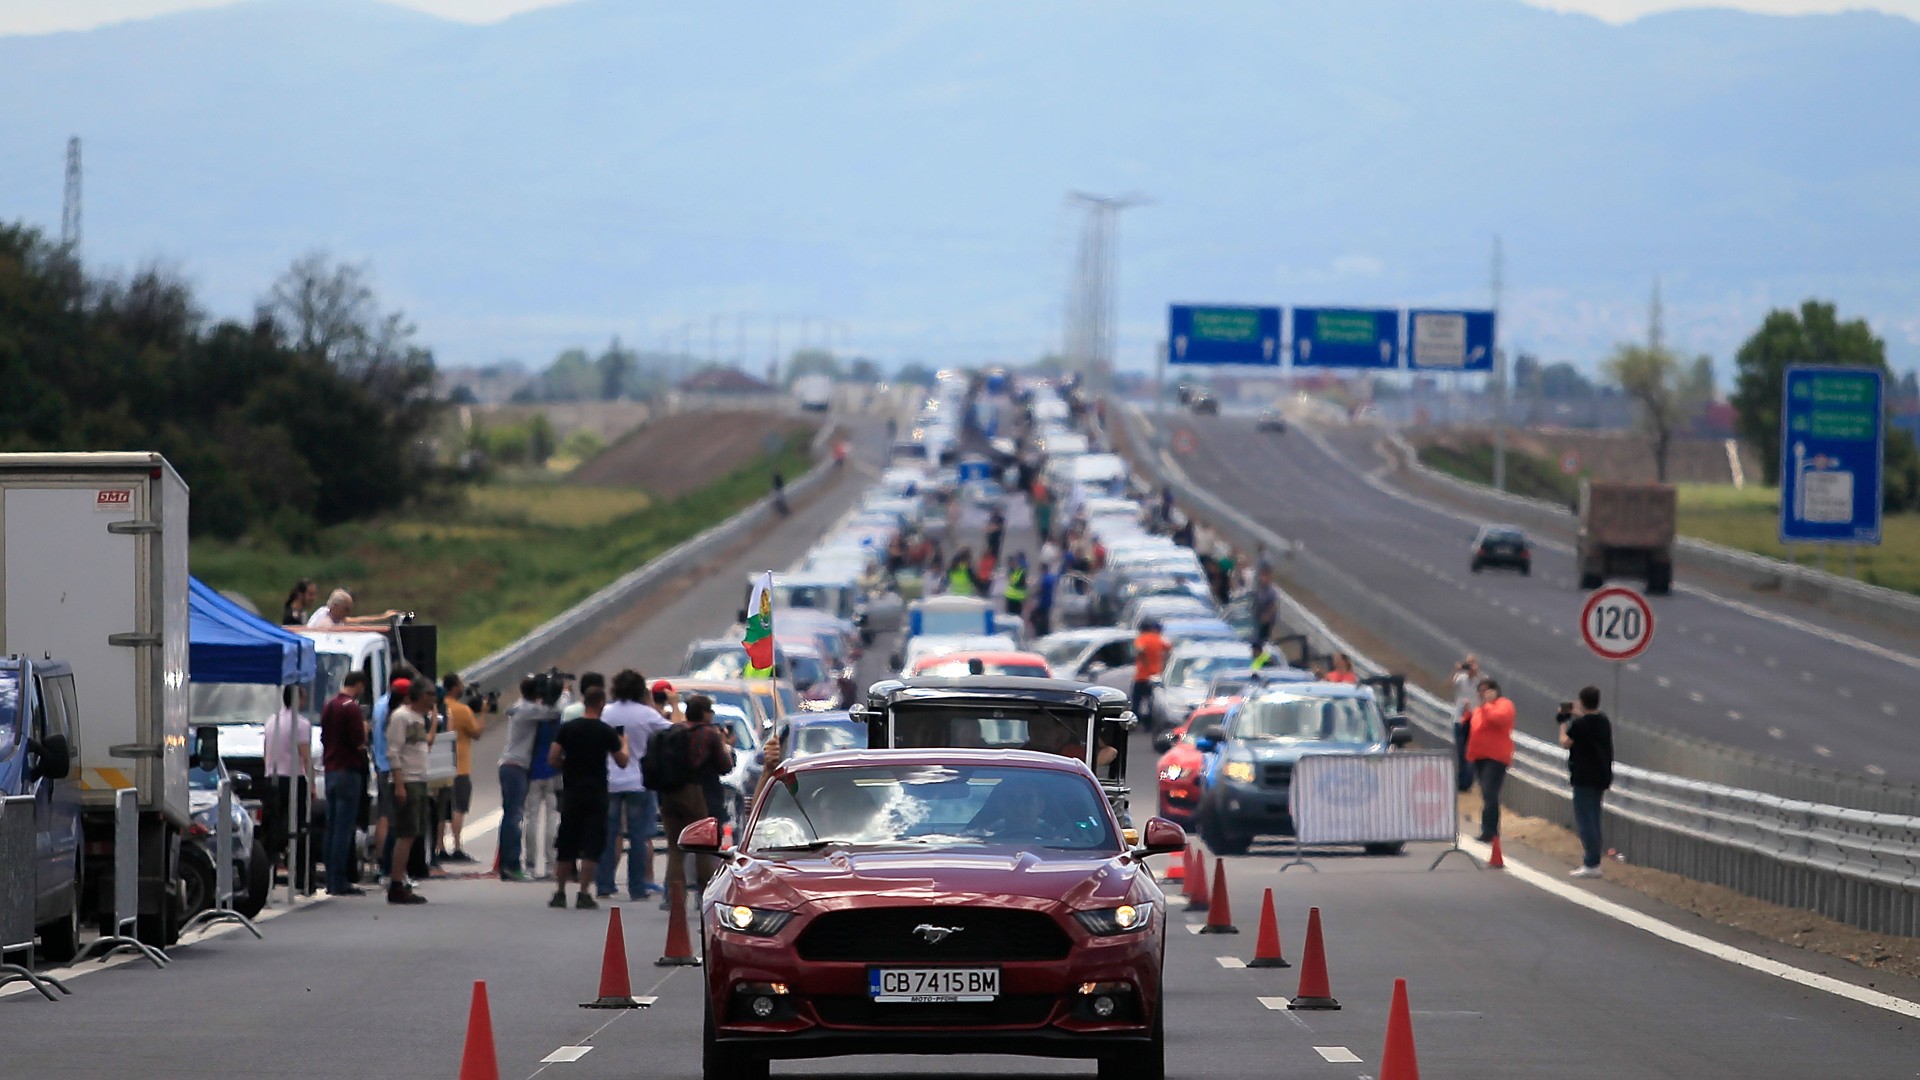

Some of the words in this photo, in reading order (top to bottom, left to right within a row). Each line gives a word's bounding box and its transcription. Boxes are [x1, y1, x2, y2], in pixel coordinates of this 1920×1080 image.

[1597, 606, 1640, 640] 120
[883, 972, 910, 993] CB
[915, 972, 964, 993] 7415
[969, 972, 996, 993] BM
